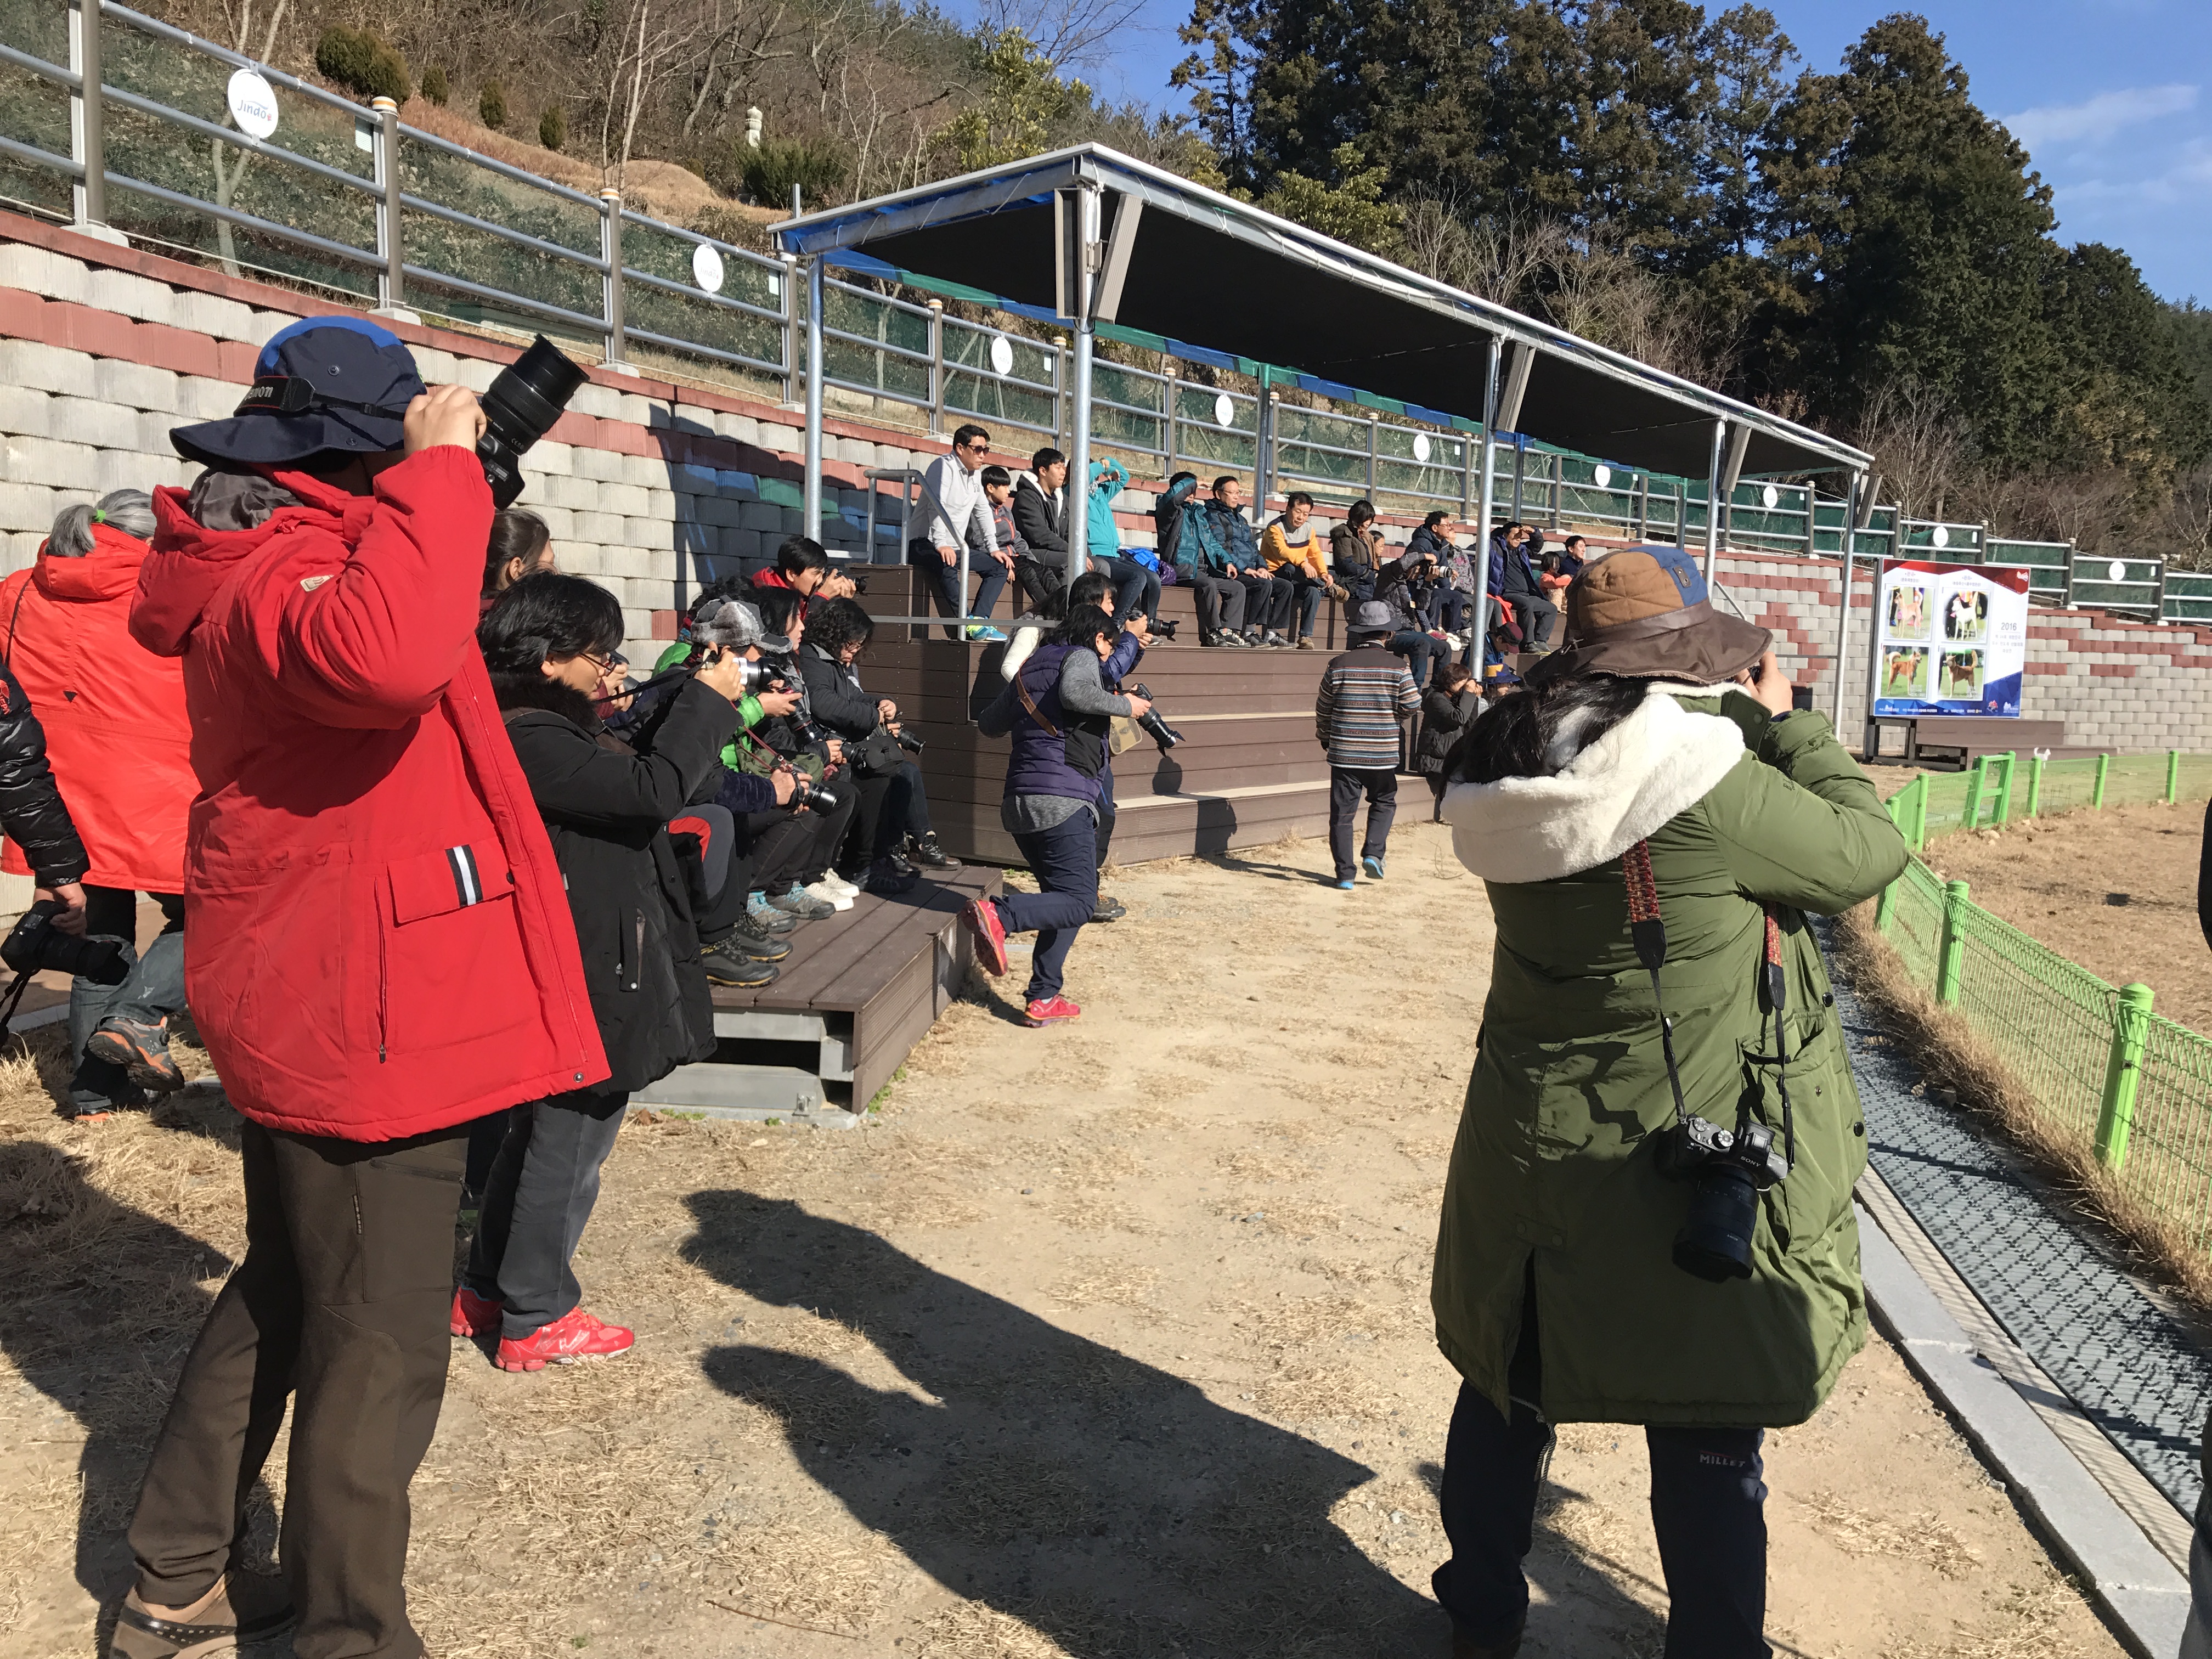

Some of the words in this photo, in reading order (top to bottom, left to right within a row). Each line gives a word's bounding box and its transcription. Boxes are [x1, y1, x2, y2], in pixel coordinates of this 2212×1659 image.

[237, 99, 267, 119] Jindo
[2001, 622, 2017, 631] 2016
[1740, 1155, 1761, 1167] SONY
[1700, 1454, 1746, 1468] MILLET
